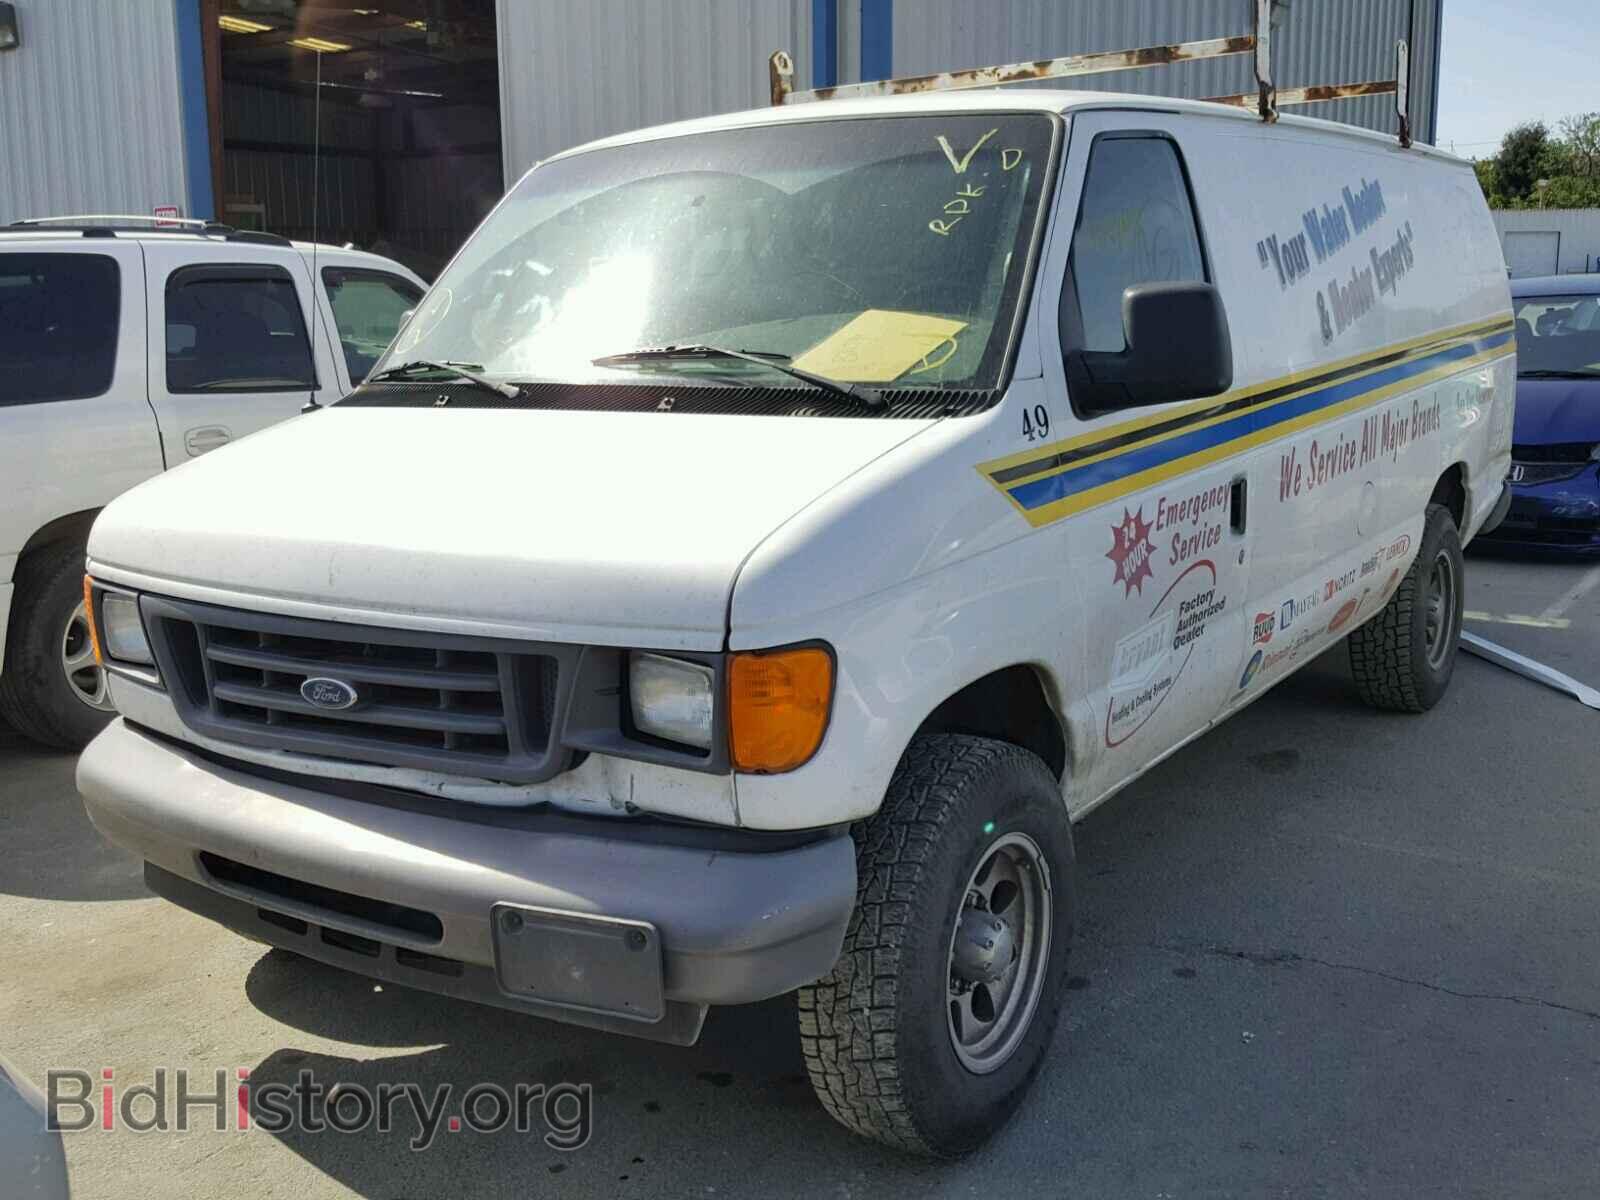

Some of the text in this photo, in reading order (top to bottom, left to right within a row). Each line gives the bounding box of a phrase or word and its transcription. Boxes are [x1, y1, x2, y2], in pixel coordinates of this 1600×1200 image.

[1022, 404, 1049, 442] 49
[1279, 446, 1302, 502] We
[1307, 433, 1357, 490] Service
[1360, 413, 1378, 468] All
[1381, 407, 1410, 464] Major
[1411, 391, 1441, 442] Brands
[1156, 481, 1232, 531] Emergency
[1169, 523, 1221, 566] Service
[1176, 595, 1227, 635] Authorized
[1179, 589, 1216, 618] Factory
[1173, 624, 1205, 651] Dealer
